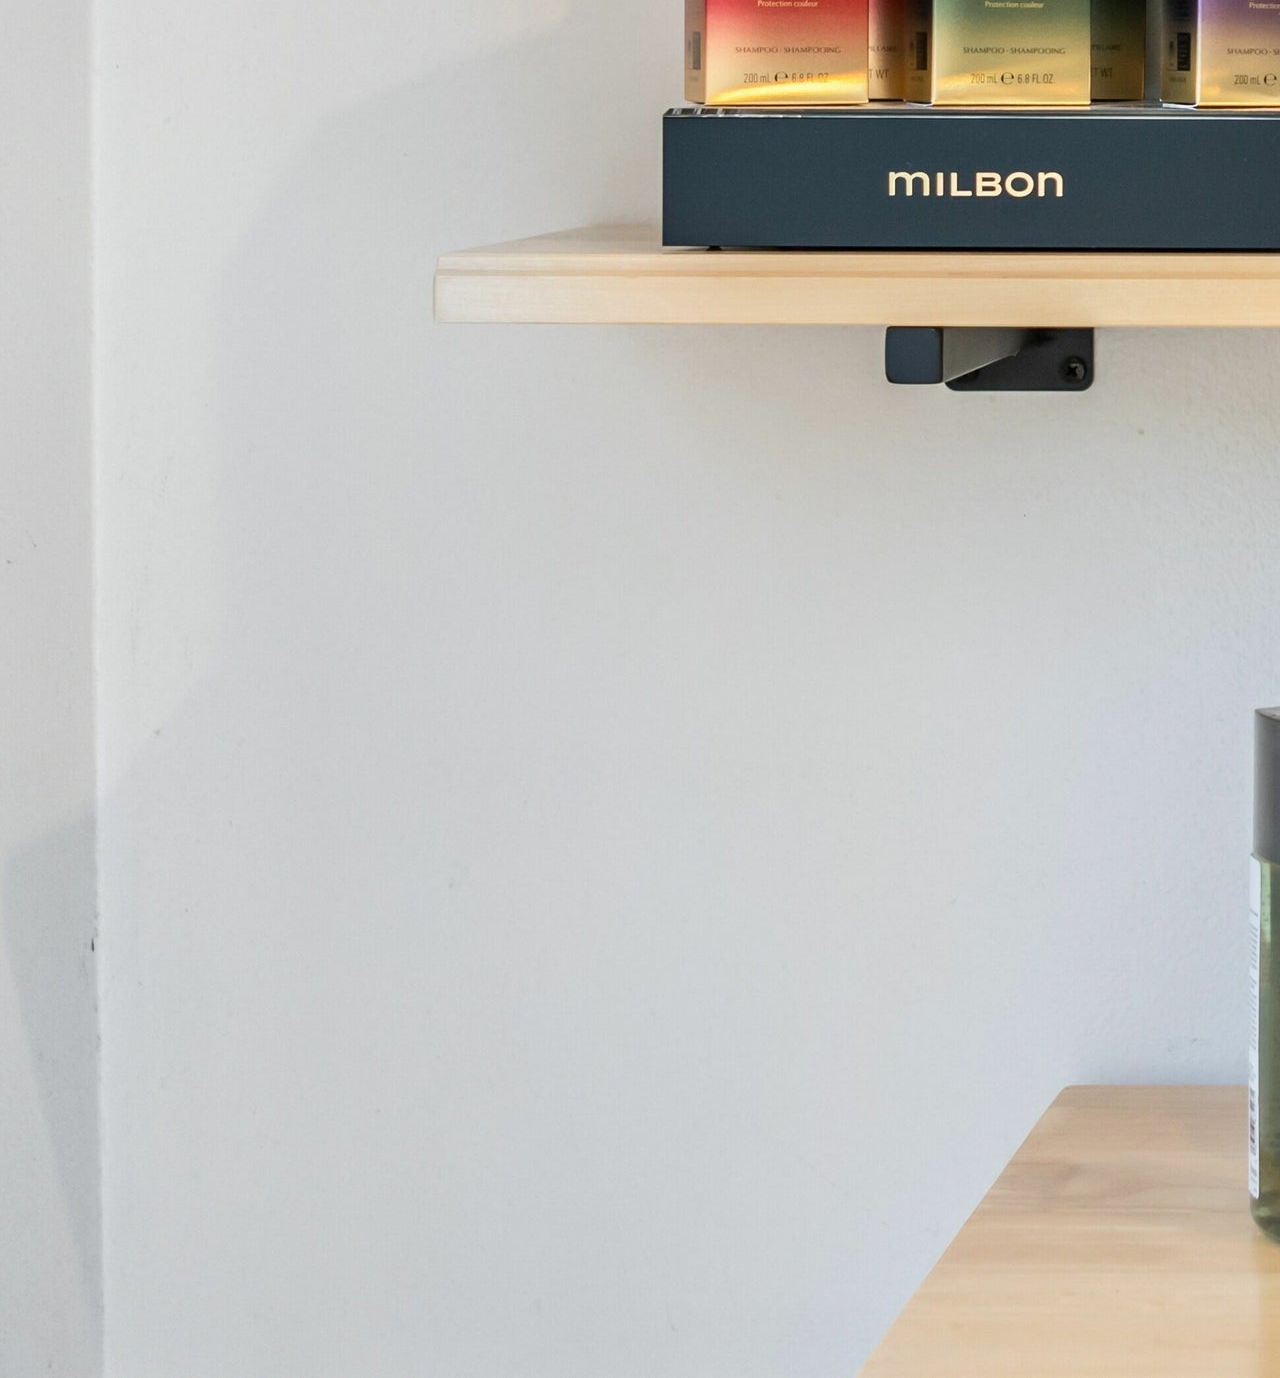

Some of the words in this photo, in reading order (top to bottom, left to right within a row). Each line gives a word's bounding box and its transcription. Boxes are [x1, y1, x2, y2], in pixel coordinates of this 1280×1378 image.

[735, 46, 779, 54] SHAMPOO
[1017, 73, 1030, 84] 6.8
[1234, 74, 1248, 85] 200
